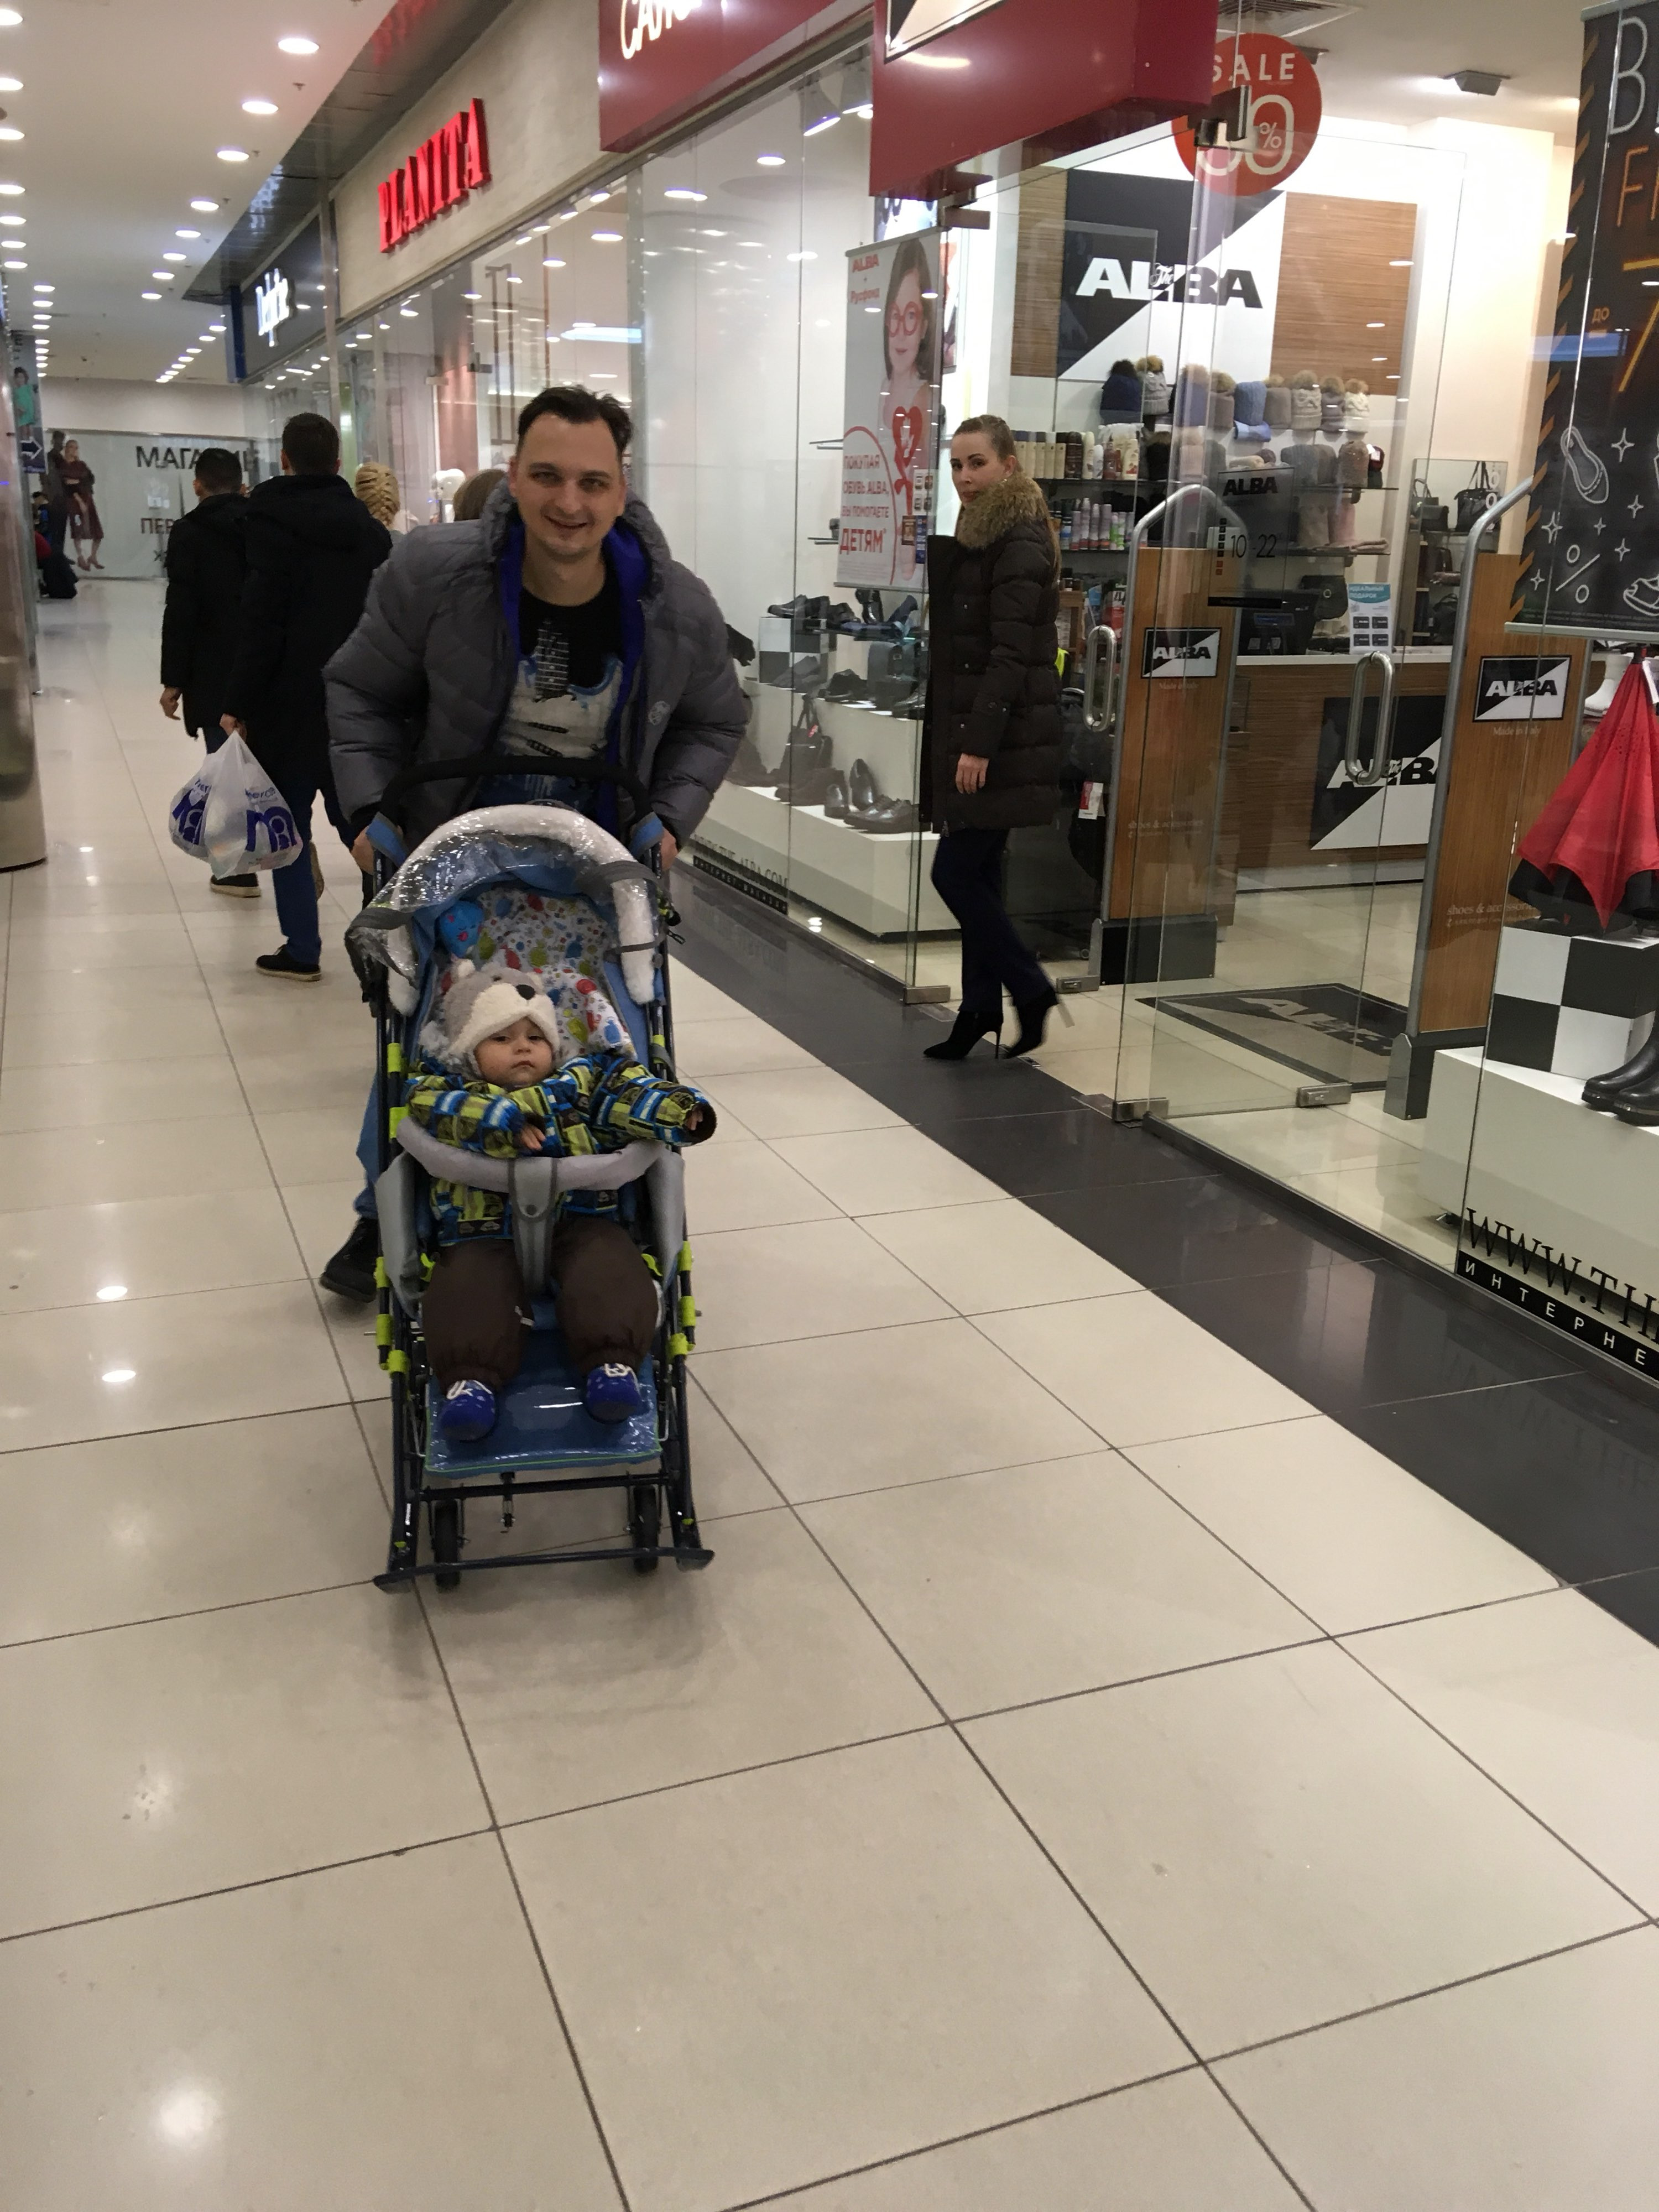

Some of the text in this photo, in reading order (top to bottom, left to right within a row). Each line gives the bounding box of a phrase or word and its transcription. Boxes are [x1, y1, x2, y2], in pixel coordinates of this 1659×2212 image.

[1213, 53, 1295, 81] SALE
[378, 98, 490, 253] PLANITA
[852, 254, 880, 273] ALBA
[1076, 257, 1263, 309] ALBA
[844, 455, 880, 469] ПОКУПАЯ
[843, 481, 865, 495] ОБУВЬ
[1223, 477, 1279, 496] ALBA
[1153, 646, 1211, 660] ALBA
[1485, 680, 1558, 698] ALBA
[1525, 726, 1542, 738] Ialy
[1447, 904, 1474, 916] shoes
